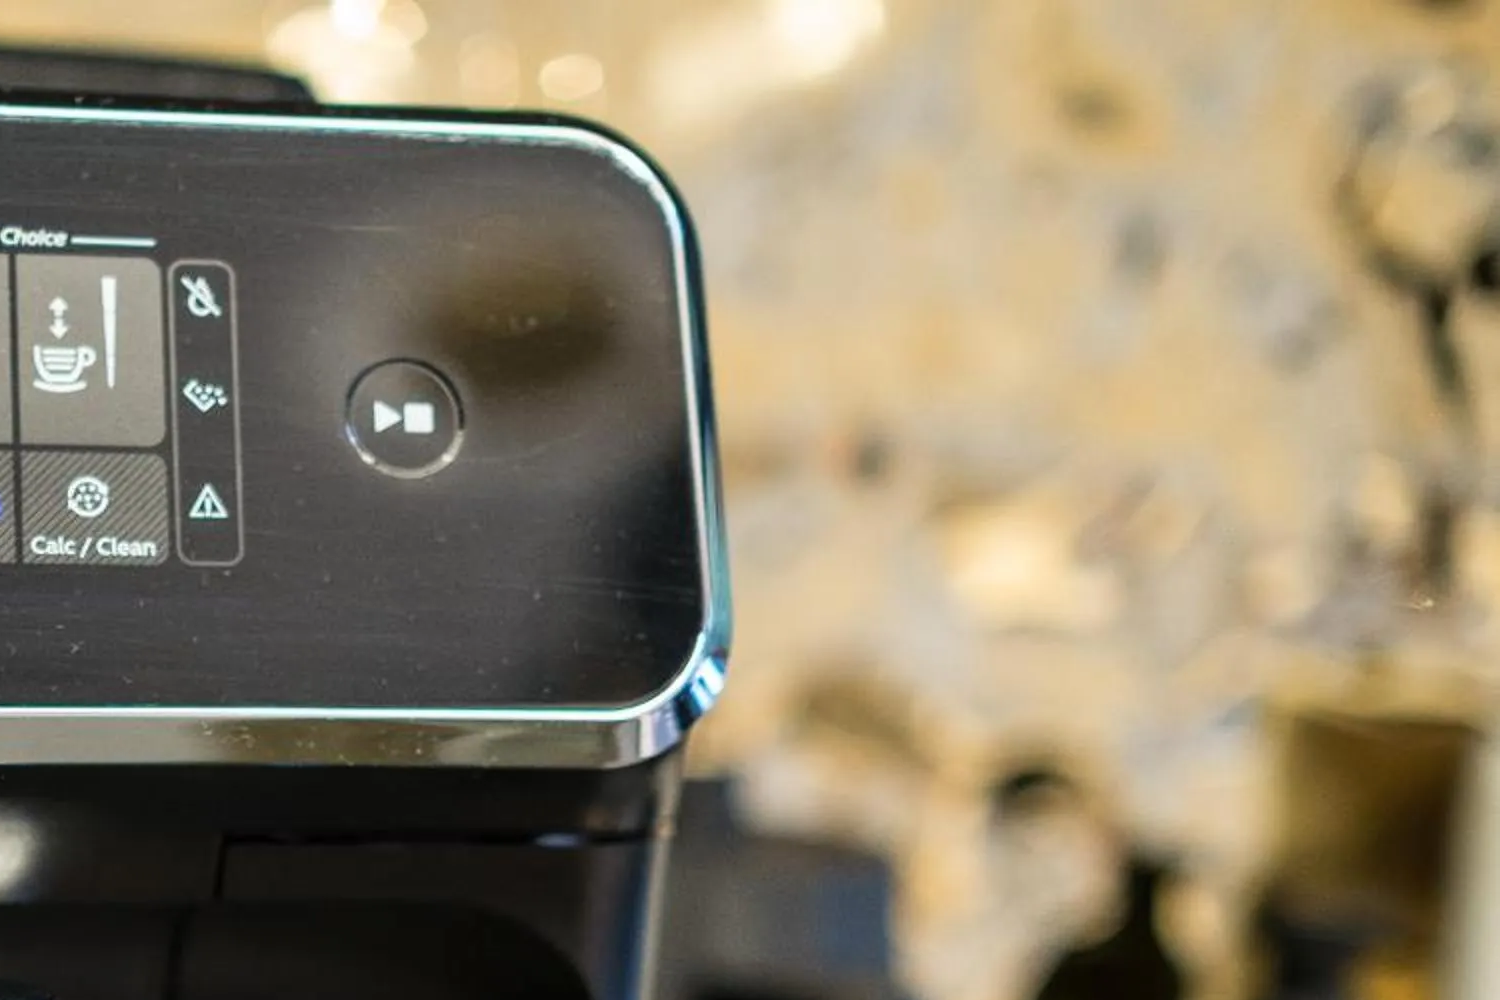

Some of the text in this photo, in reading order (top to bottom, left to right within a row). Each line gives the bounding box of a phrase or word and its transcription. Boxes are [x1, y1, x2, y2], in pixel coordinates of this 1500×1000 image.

[0, 230, 67, 248] Choice
[30, 536, 77, 554] Calc
[96, 538, 157, 557] Clean
